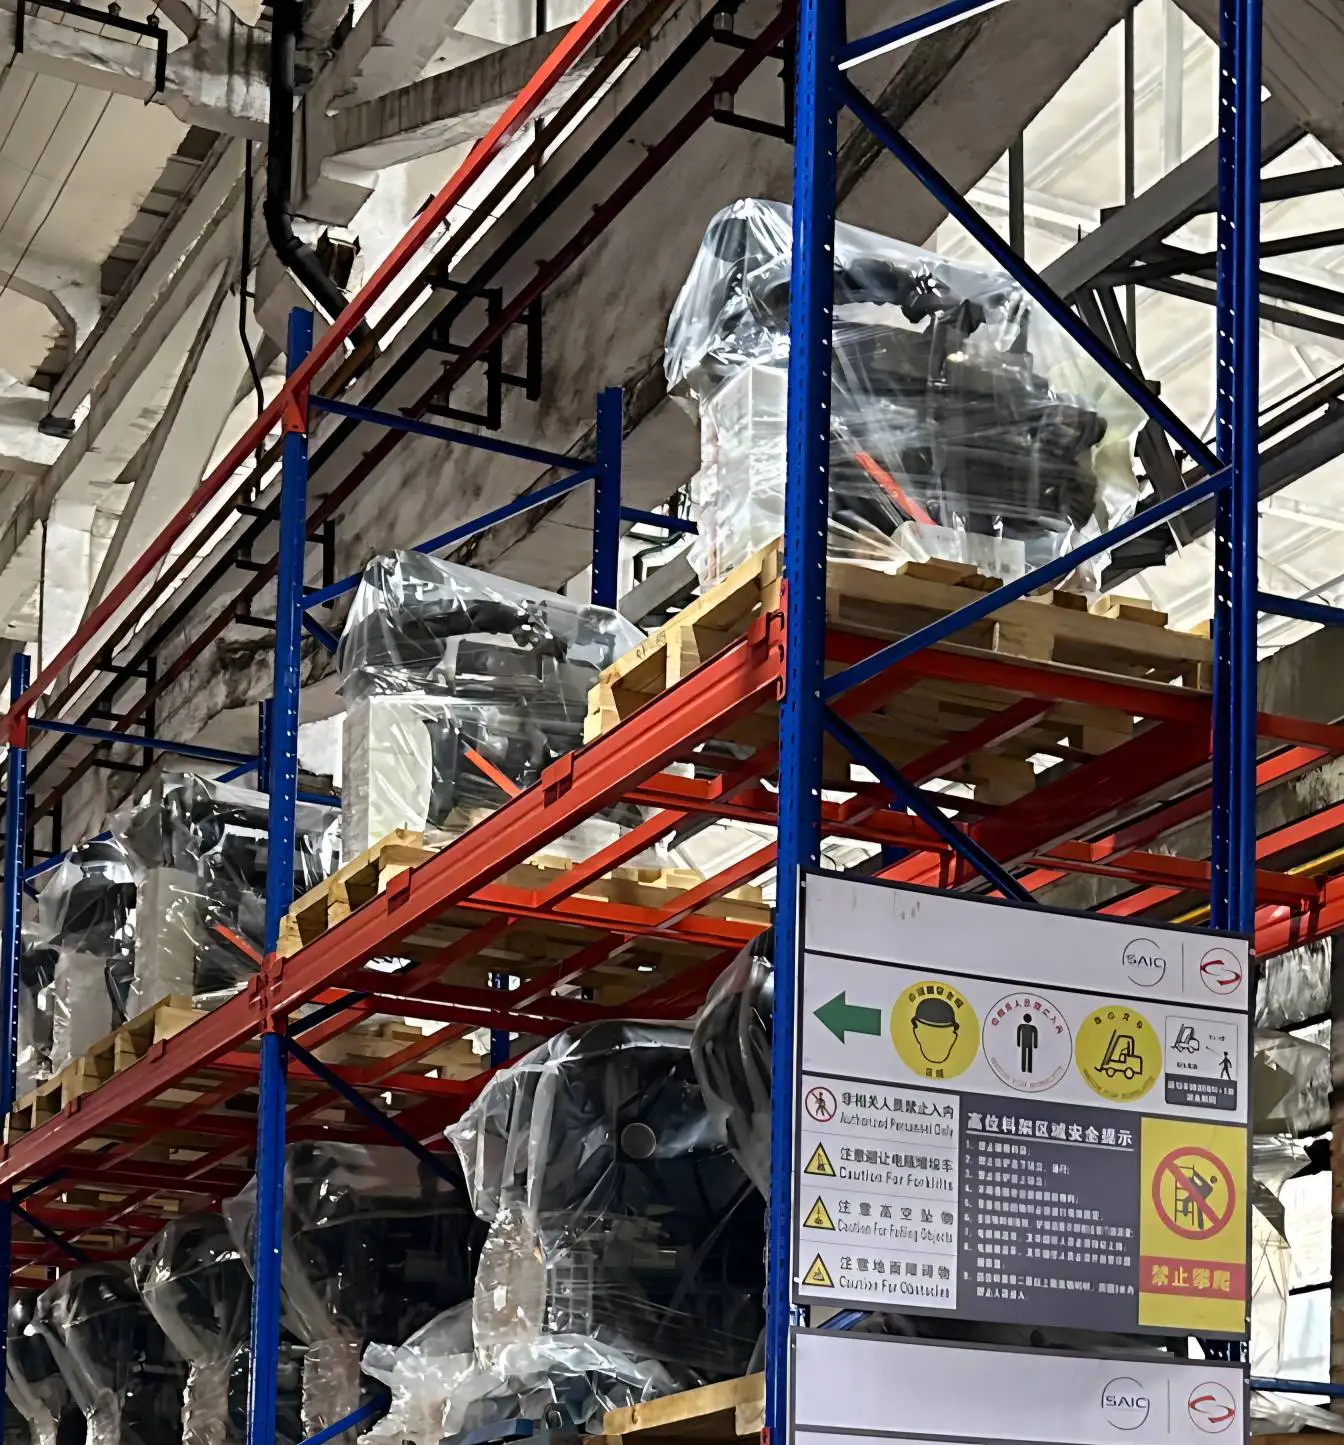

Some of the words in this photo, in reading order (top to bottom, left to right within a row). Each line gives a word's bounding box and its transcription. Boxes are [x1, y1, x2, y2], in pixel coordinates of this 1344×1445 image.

[1151, 1264, 1231, 1292] 禁止攀爬
[1105, 1395, 1150, 1409] SAIC
